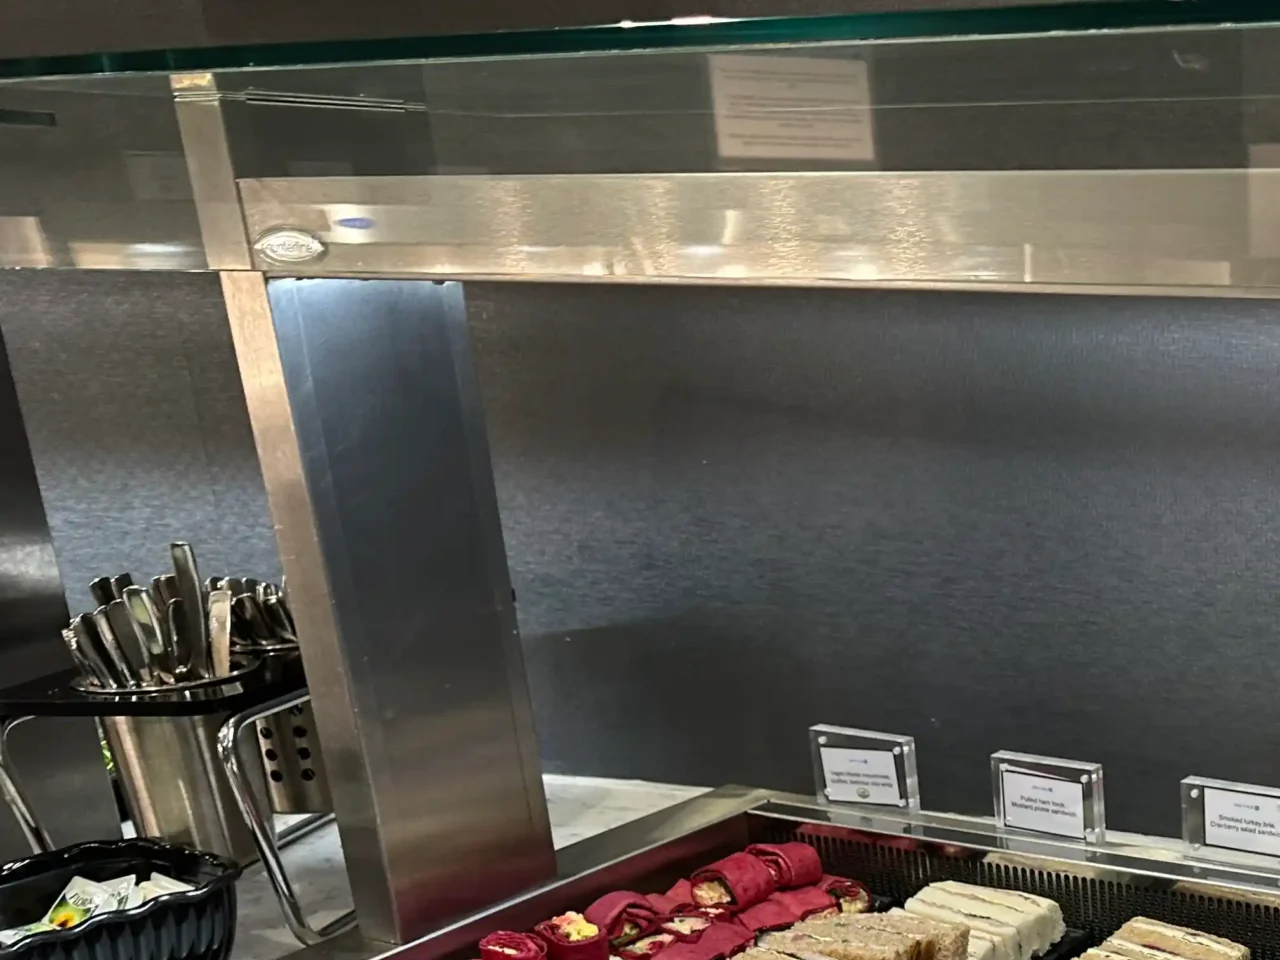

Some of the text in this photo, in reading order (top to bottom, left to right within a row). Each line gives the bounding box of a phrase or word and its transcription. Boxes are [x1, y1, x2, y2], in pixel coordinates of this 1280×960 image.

[1210, 821, 1239, 832] Cranberry
[1240, 826, 1257, 834] salad
[1219, 814, 1242, 824] Smoked
[1244, 818, 1262, 828] turkey
